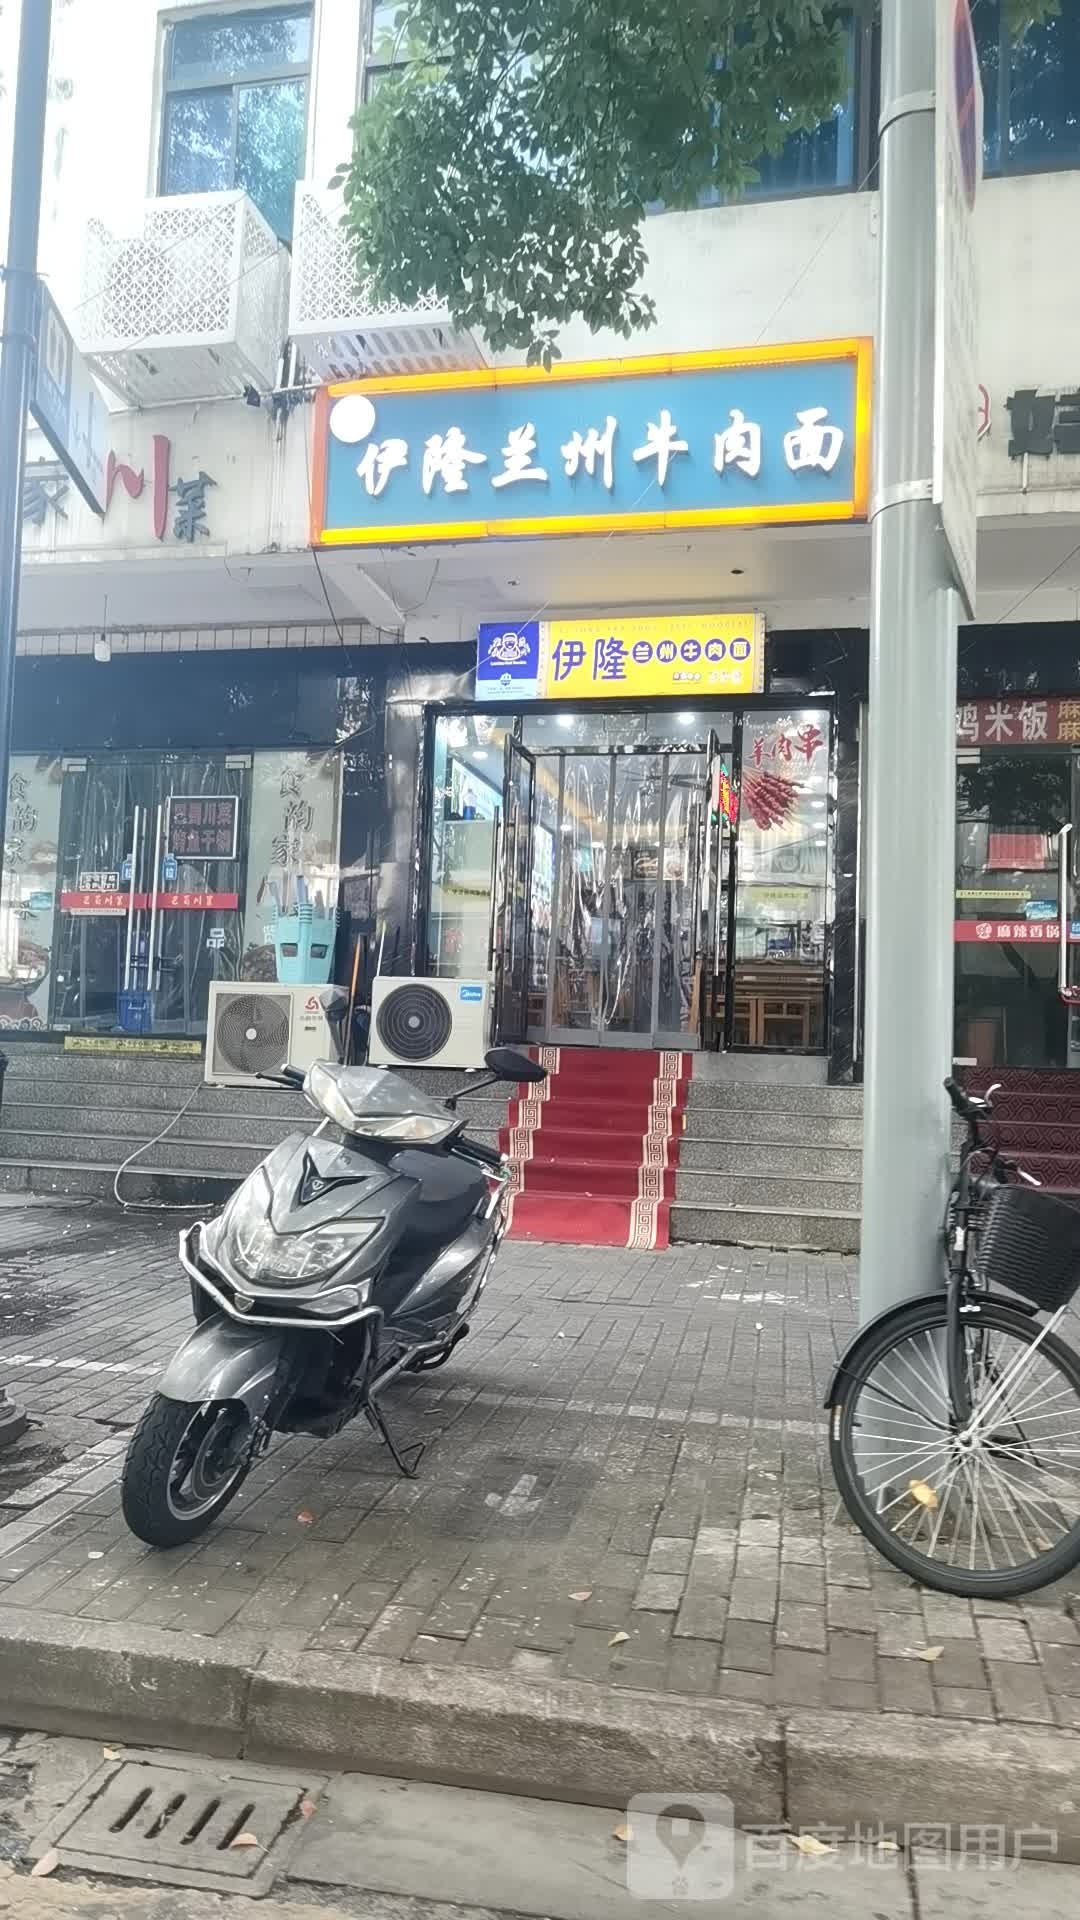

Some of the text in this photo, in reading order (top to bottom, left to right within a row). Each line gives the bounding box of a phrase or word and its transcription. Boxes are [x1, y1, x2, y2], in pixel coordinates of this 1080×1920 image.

[356, 407, 844, 496] 伊隆兰州牛肉面
[552, 636, 751, 681] 伊隆兰州牛肉面
